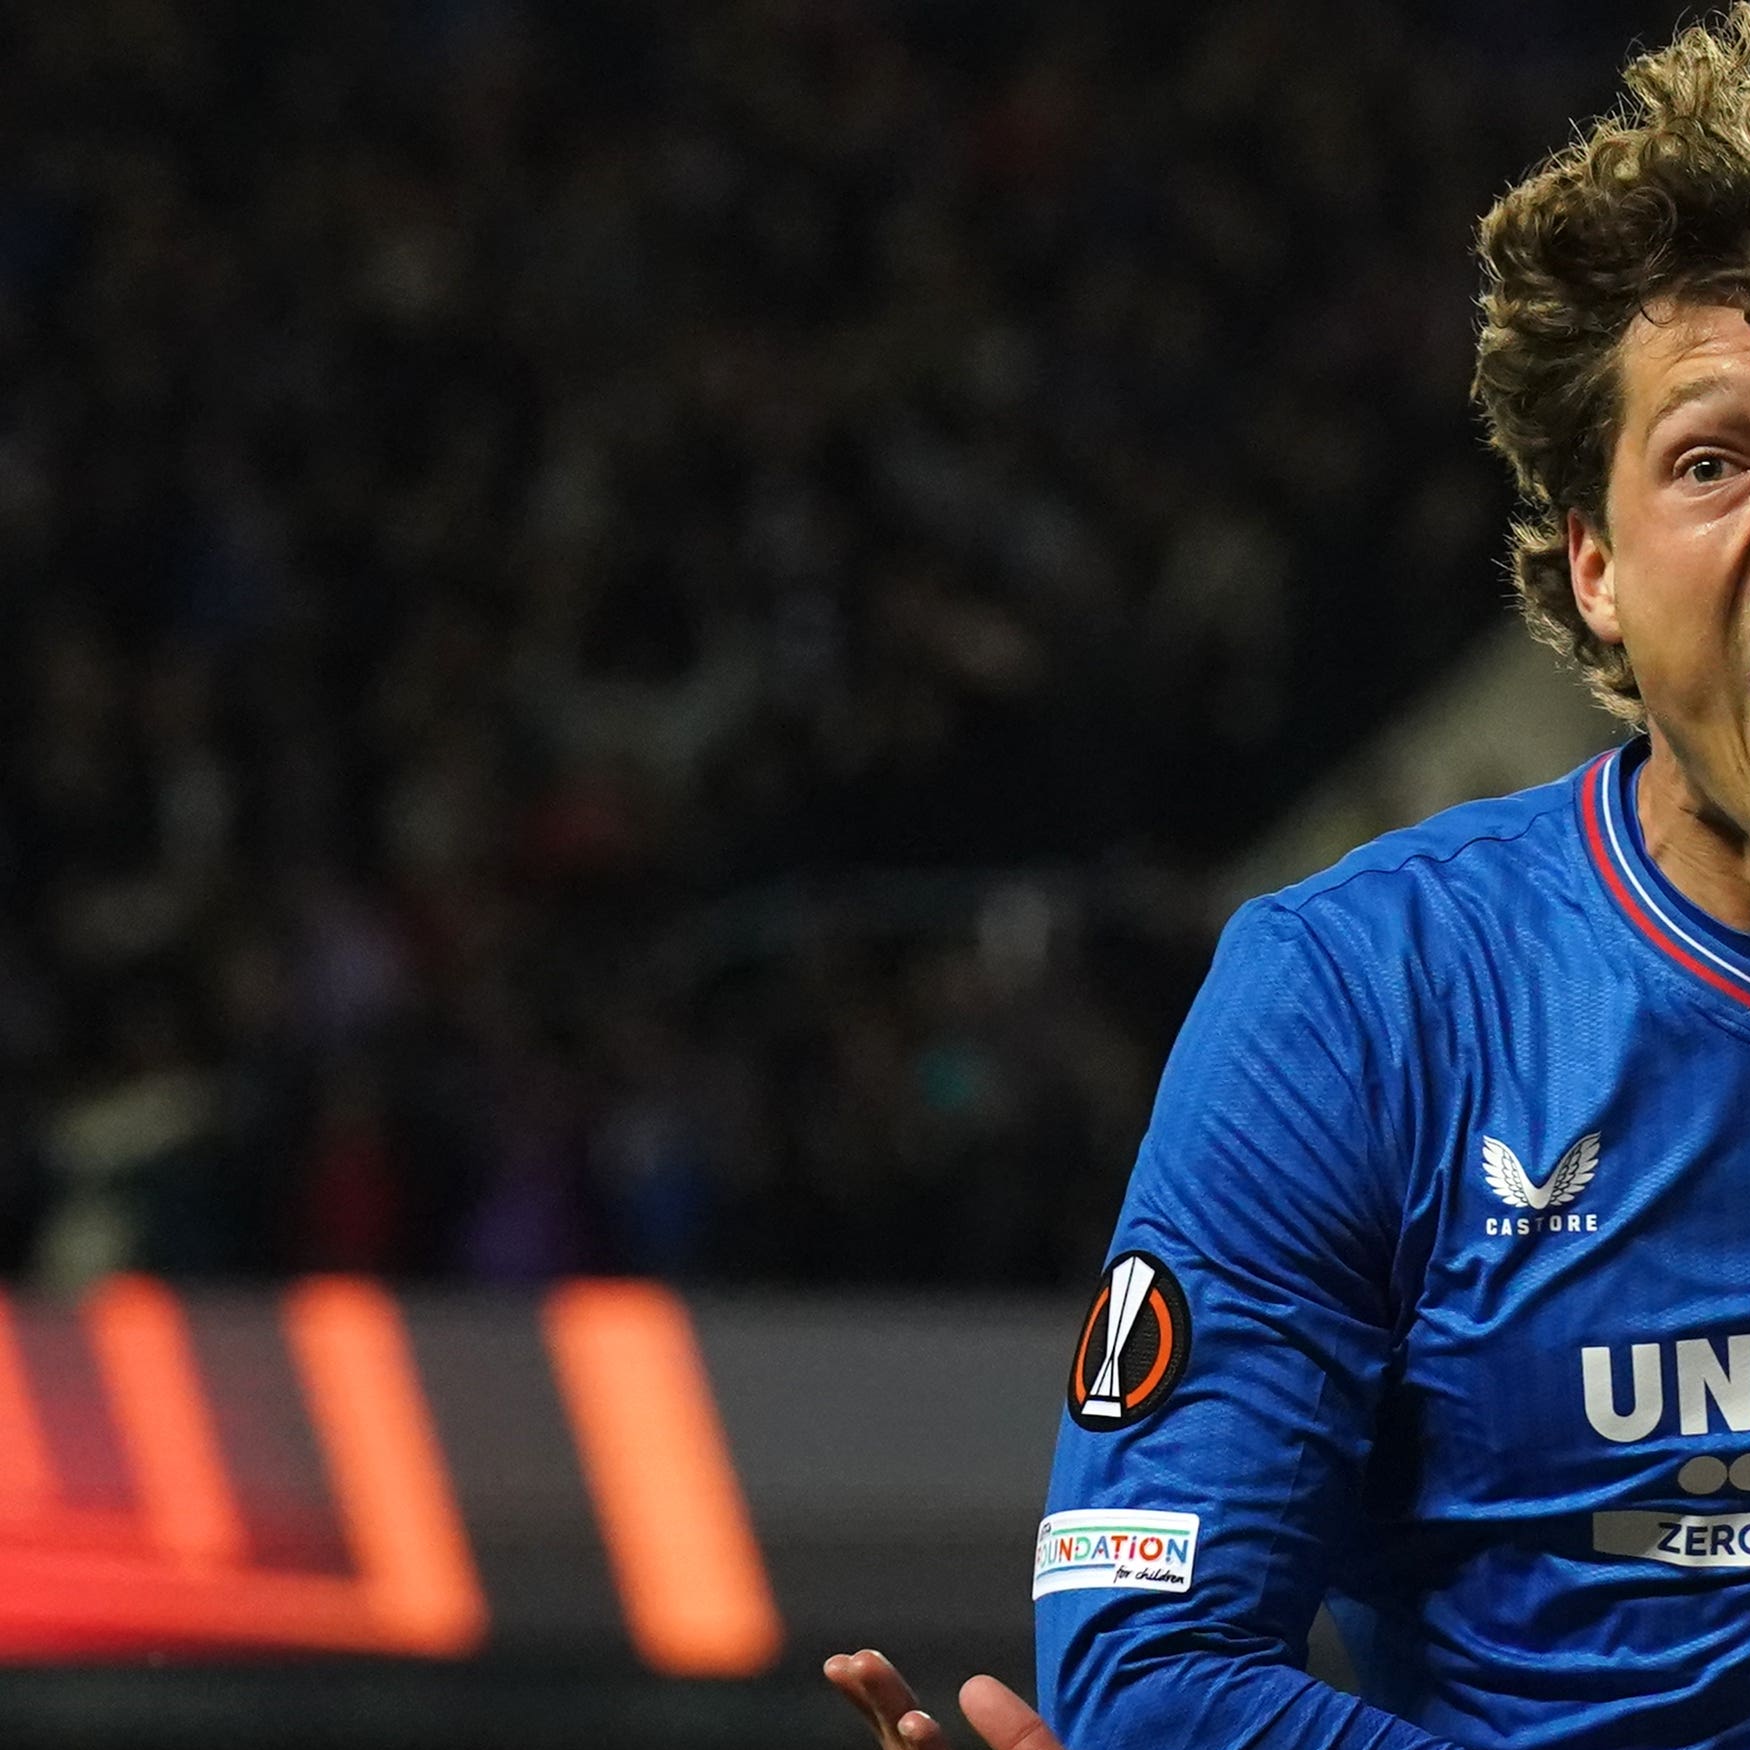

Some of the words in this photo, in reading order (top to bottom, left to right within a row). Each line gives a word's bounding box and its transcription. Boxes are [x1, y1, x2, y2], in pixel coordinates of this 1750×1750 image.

[1485, 1214, 1599, 1237] CASTORE
[1113, 1564, 1132, 1584] for
[1135, 1566, 1185, 1585] children
